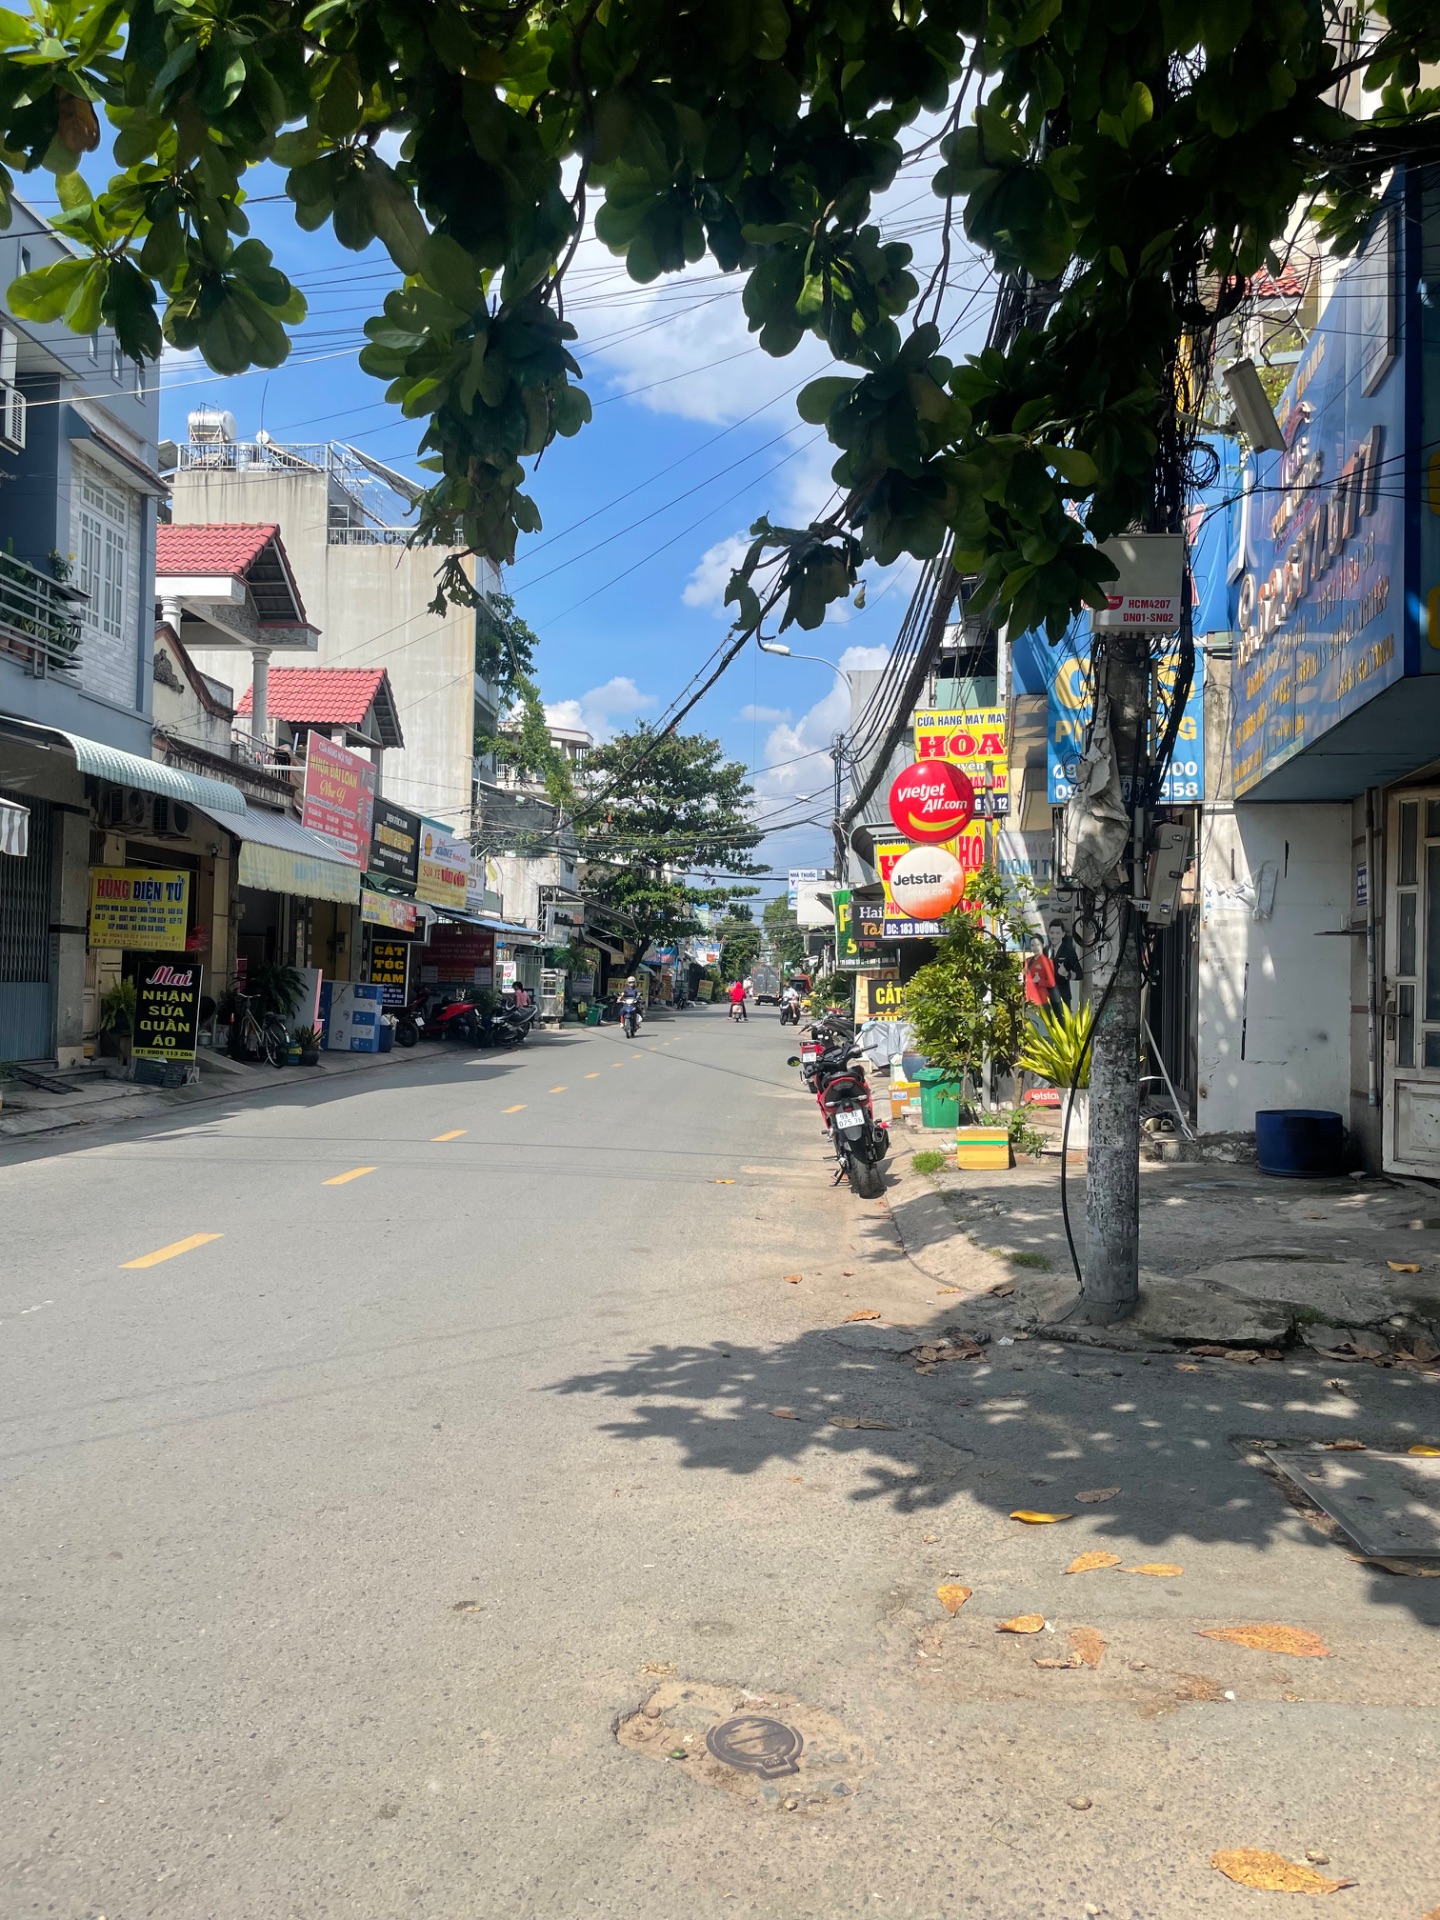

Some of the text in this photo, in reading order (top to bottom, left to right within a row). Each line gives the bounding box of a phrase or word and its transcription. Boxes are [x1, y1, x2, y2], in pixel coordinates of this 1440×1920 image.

[1128, 599, 1171, 609] HCM4207
[1123, 612, 1174, 623] DN01-SN02
[918, 714, 935, 727] CỬA
[938, 714, 962, 726] HÀNG
[965, 713, 985, 725] MÁY
[919, 729, 1005, 758] HÒA
[997, 797, 1007, 810] 12
[893, 873, 942, 887] Jetstar
[900, 923, 913, 934] 183
[374, 943, 405, 956] CẮT
[374, 958, 404, 970] TÓC
[146, 965, 193, 987] Mai
[372, 972, 404, 984] NAM
[142, 990, 193, 1003] NHẬN
[876, 981, 903, 1005] CẮT
[148, 1003, 185, 1017] SỬA
[140, 1018, 190, 1032] QUẦN
[152, 1034, 176, 1047] ÁO
